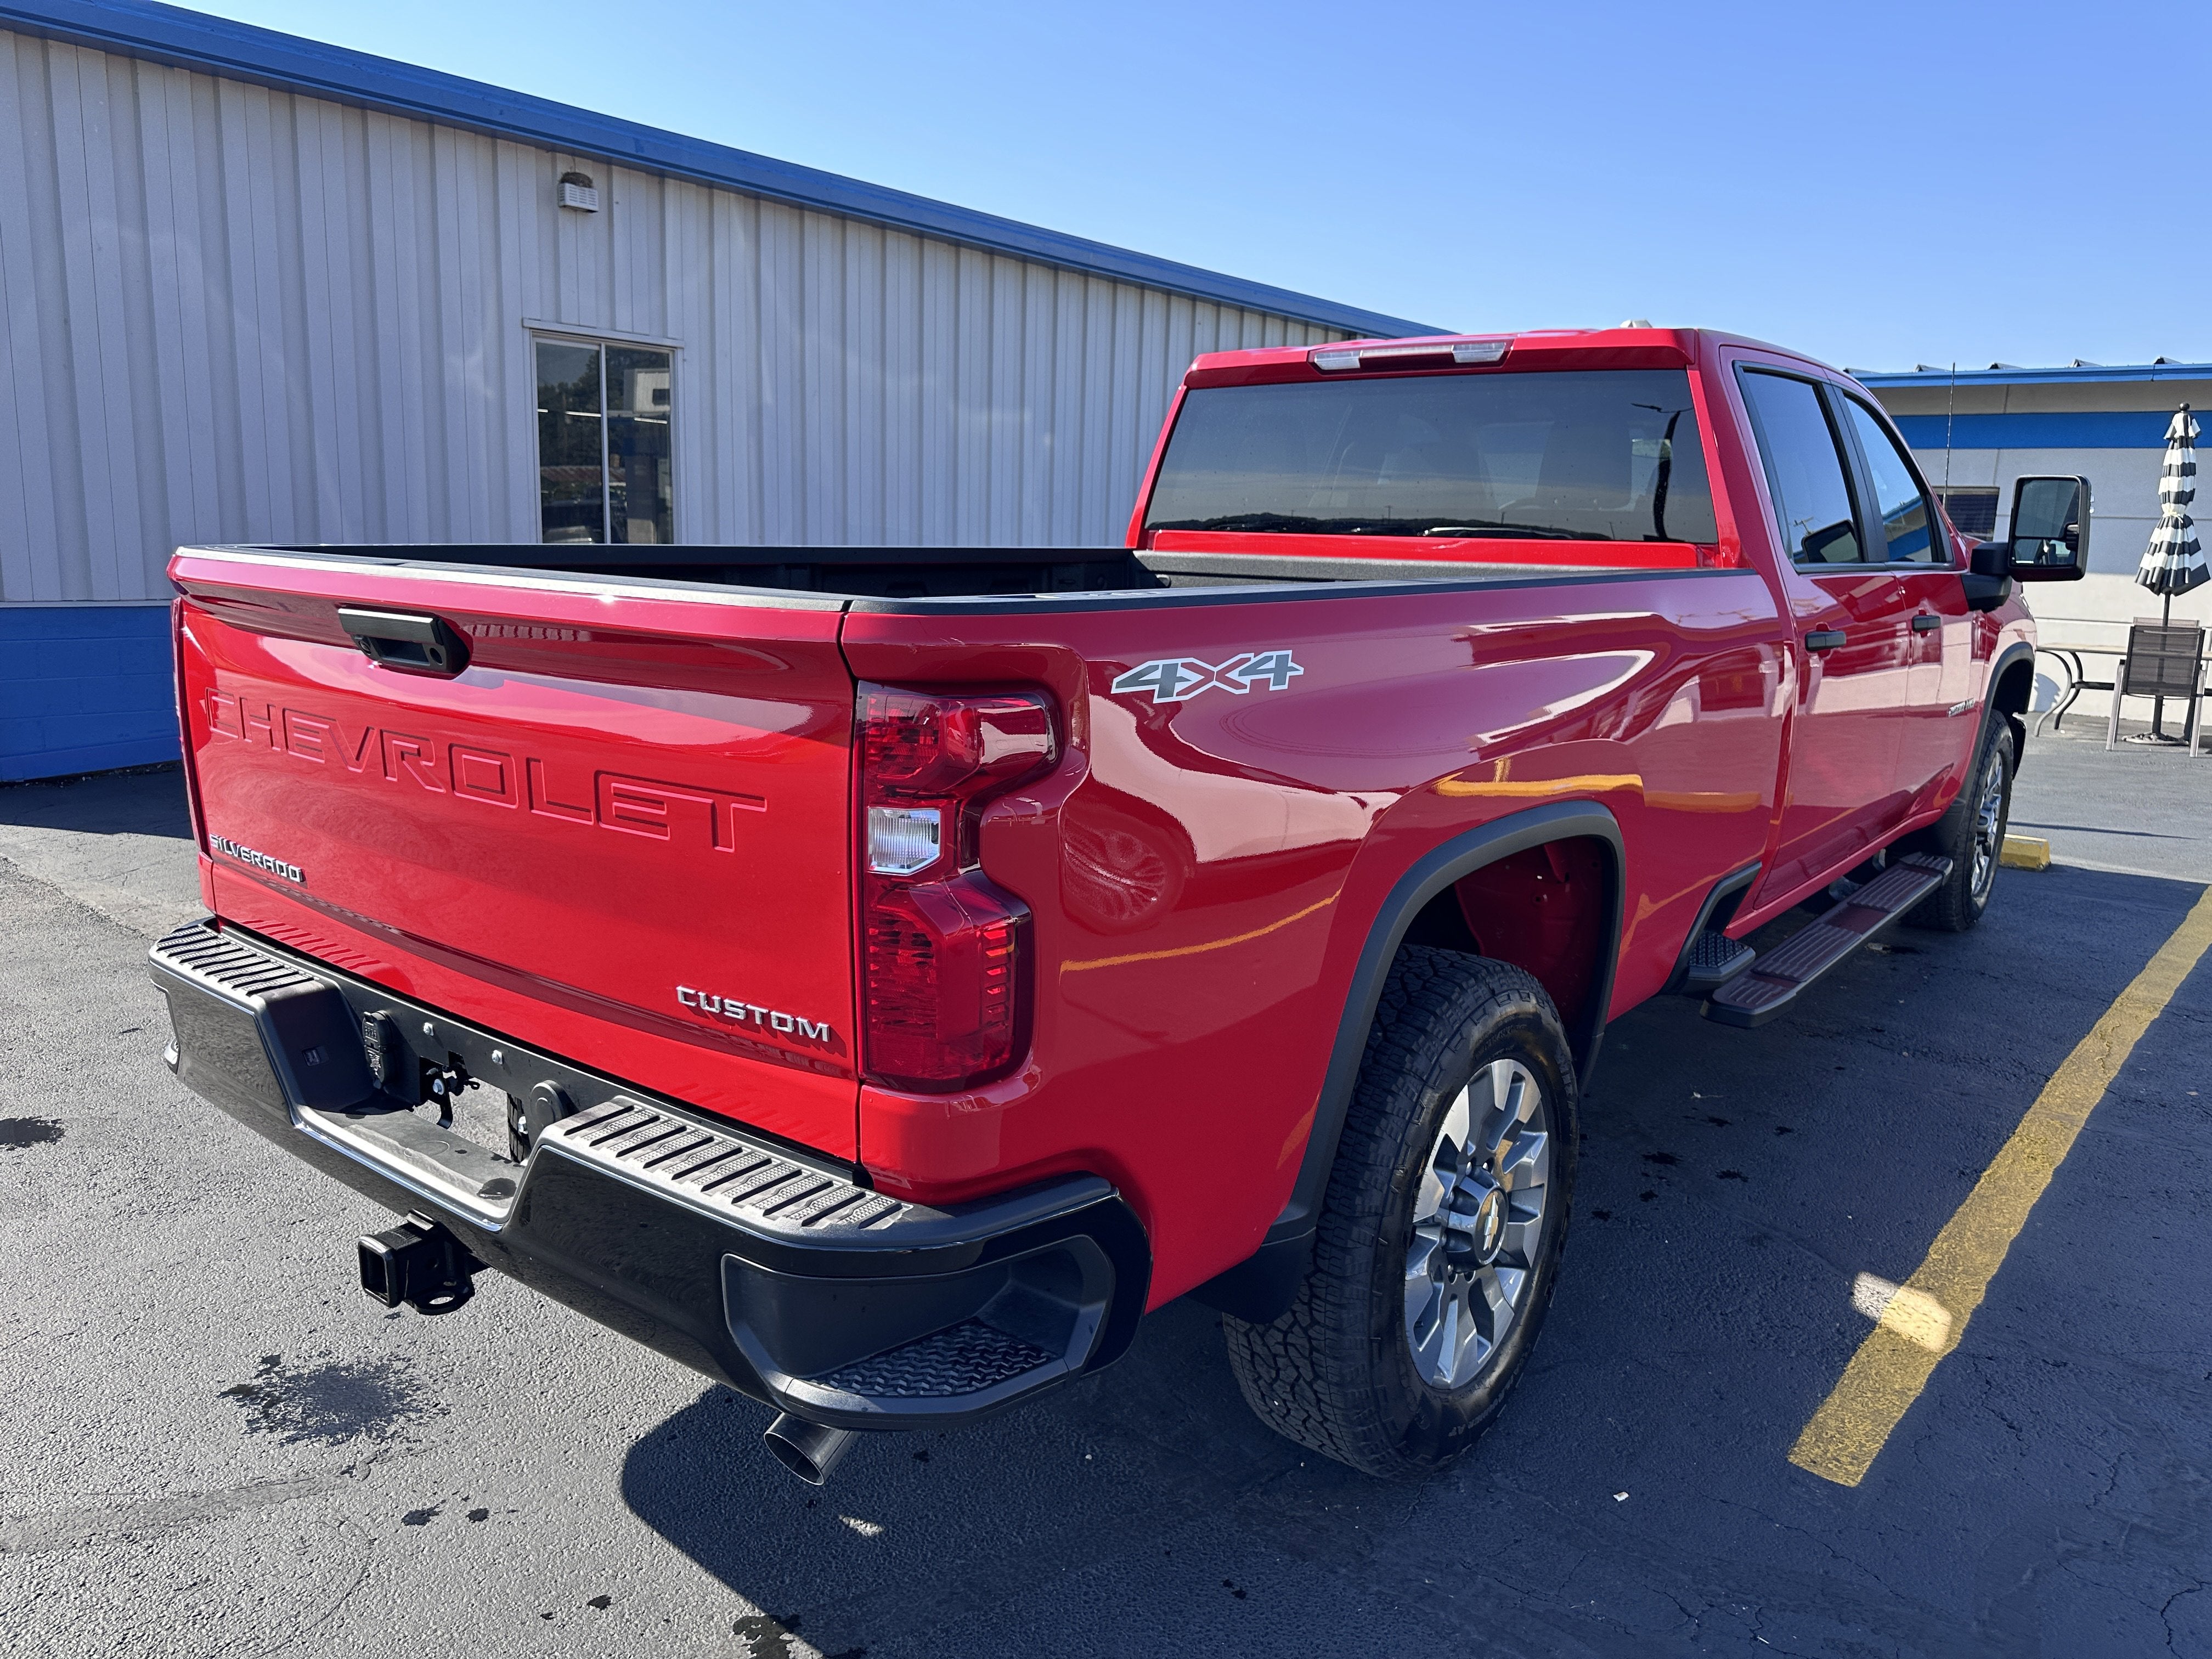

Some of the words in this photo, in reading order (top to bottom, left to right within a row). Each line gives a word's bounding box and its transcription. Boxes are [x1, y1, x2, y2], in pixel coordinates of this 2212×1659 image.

[205, 687, 768, 853] CHEVROLET
[209, 833, 306, 883] SILVERADO
[676, 985, 830, 1042] CUSTOM
